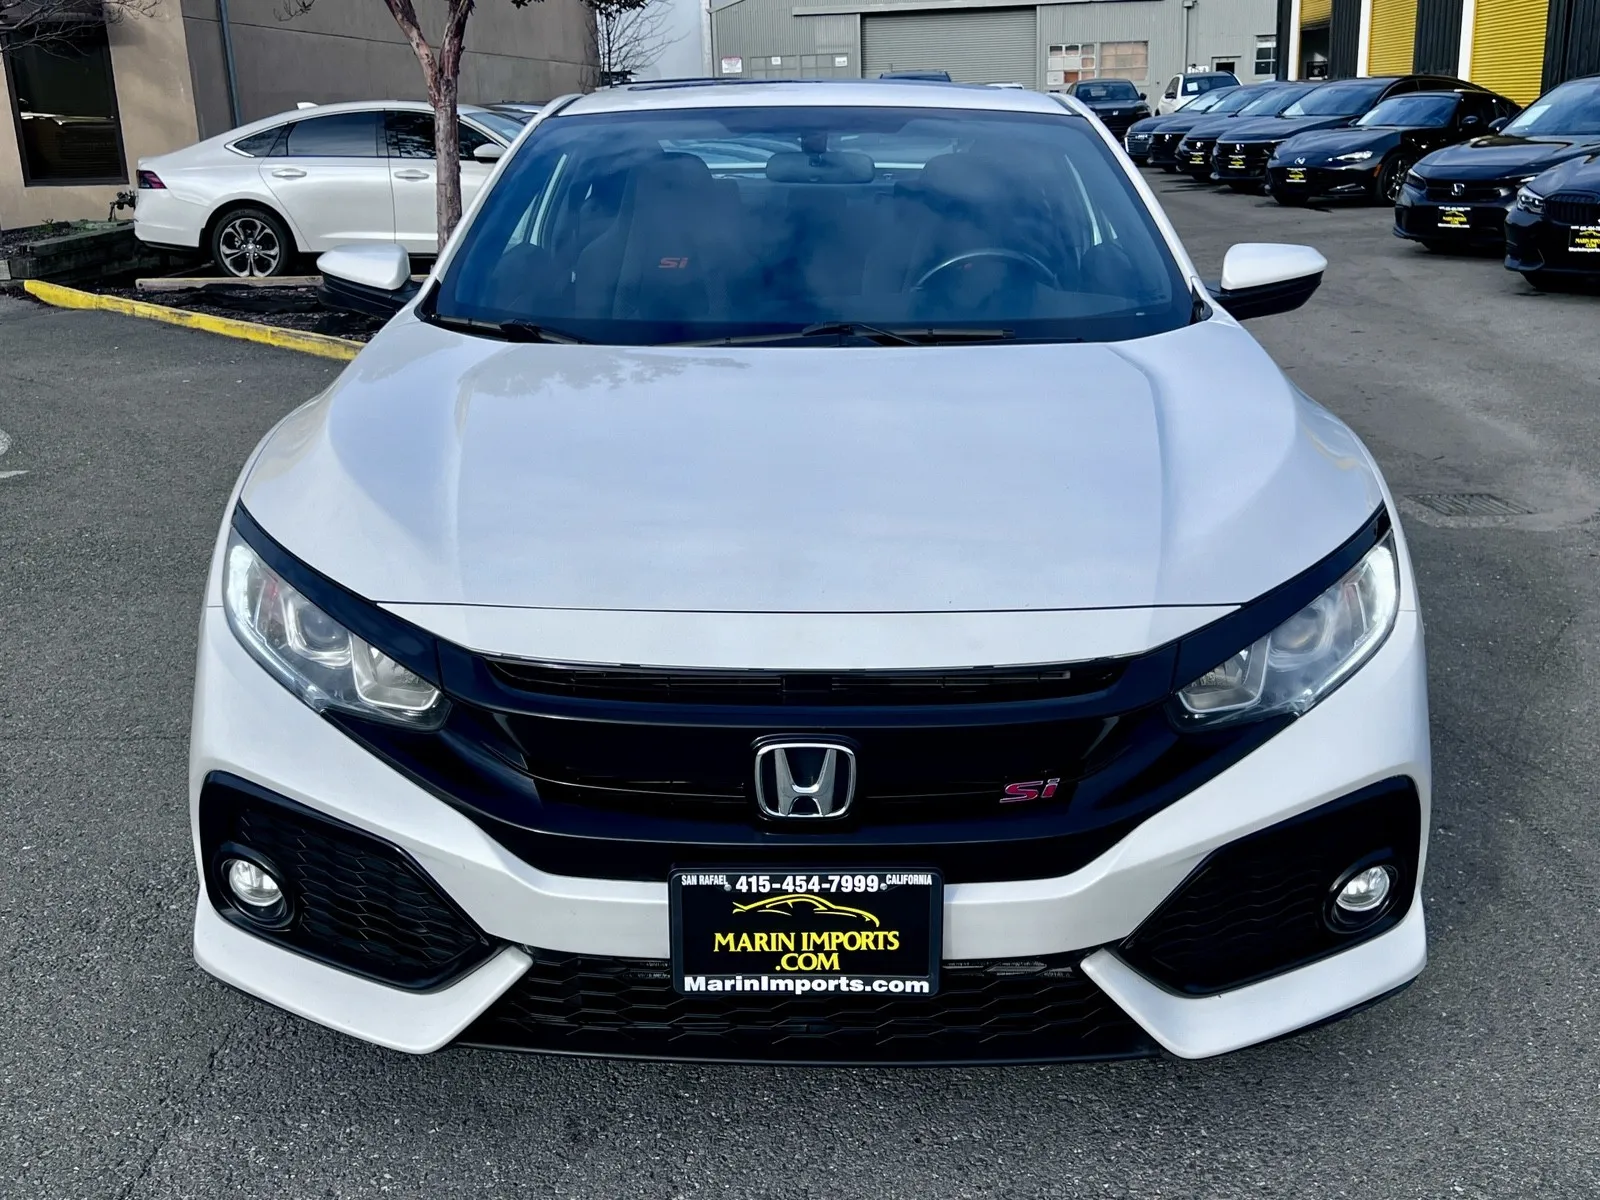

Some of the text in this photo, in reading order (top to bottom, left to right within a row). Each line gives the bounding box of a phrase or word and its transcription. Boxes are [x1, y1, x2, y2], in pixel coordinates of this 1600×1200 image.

[658, 257, 688, 268] Si
[999, 778, 1060, 804] Si
[681, 875, 728, 886] SAN RAFAEL
[735, 875, 879, 893] 415-454-7999
[885, 874, 933, 886] CALIFORNIA
[713, 931, 900, 952] MARIN IMPORTS
[775, 953, 841, 971] .COM
[684, 976, 930, 995] MarinImports.com
